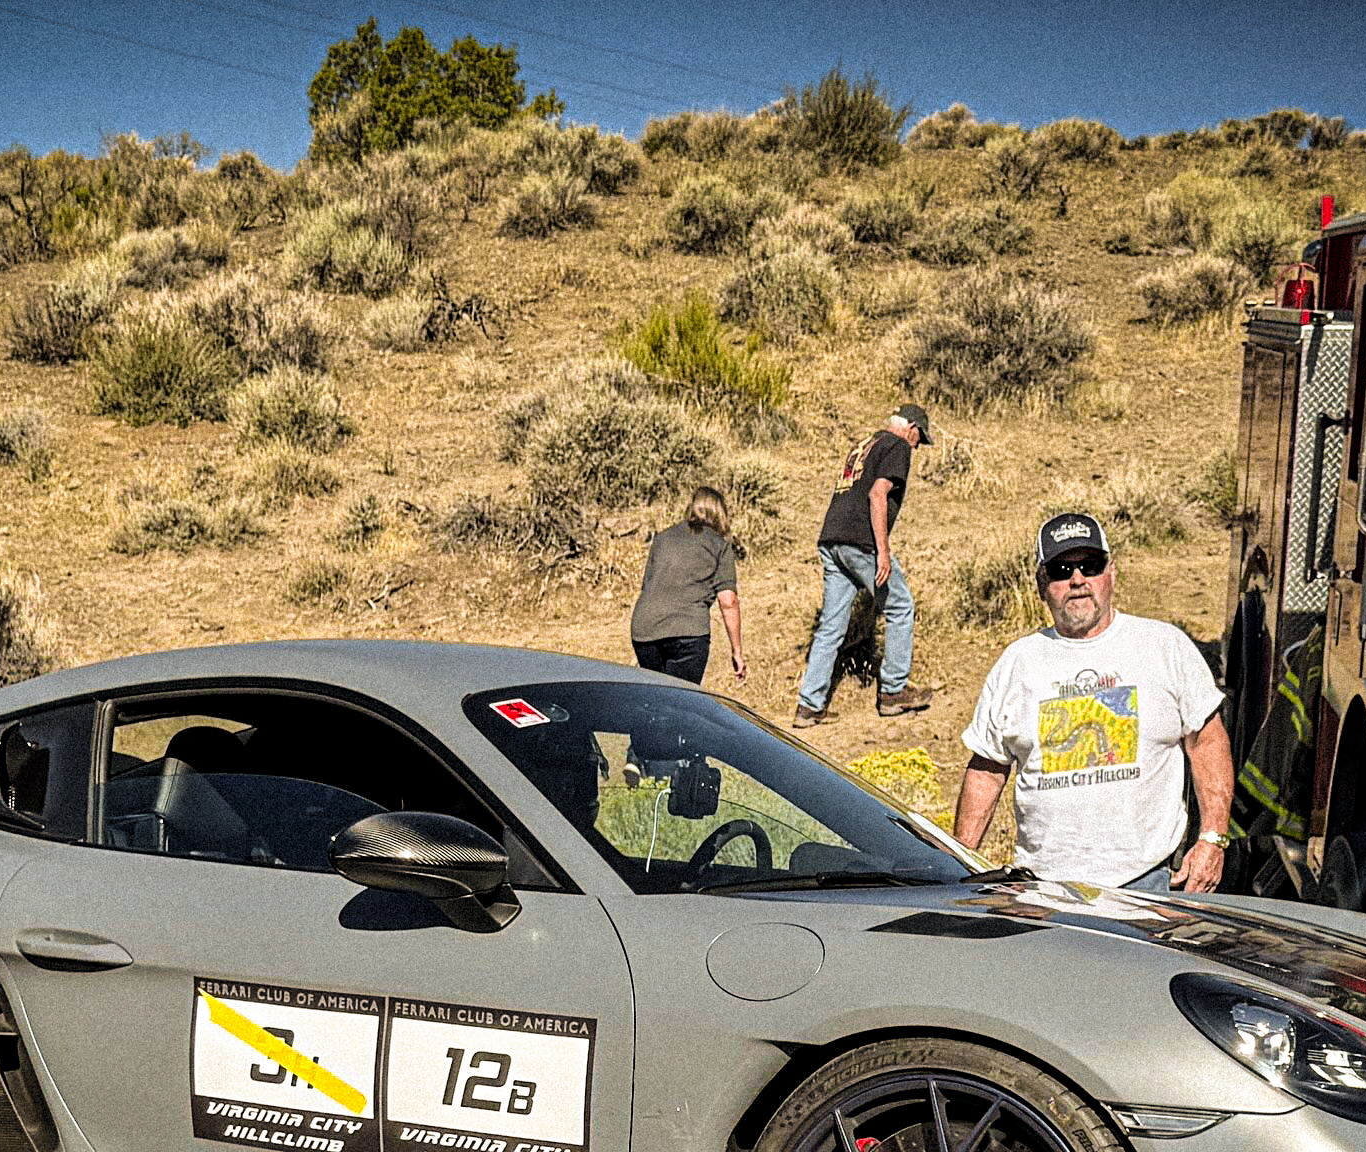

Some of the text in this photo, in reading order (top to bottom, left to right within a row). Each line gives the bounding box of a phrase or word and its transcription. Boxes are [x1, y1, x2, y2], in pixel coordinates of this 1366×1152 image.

[199, 981, 379, 1012] FERRARI CLUB OF AMERICA
[394, 1001, 589, 1035] FERRARI CLUB OF AMERICA
[442, 1047, 537, 1115] 12B
[206, 1101, 363, 1135] VIRGINIA CITY
[224, 1124, 345, 1152] HILLCLIMB
